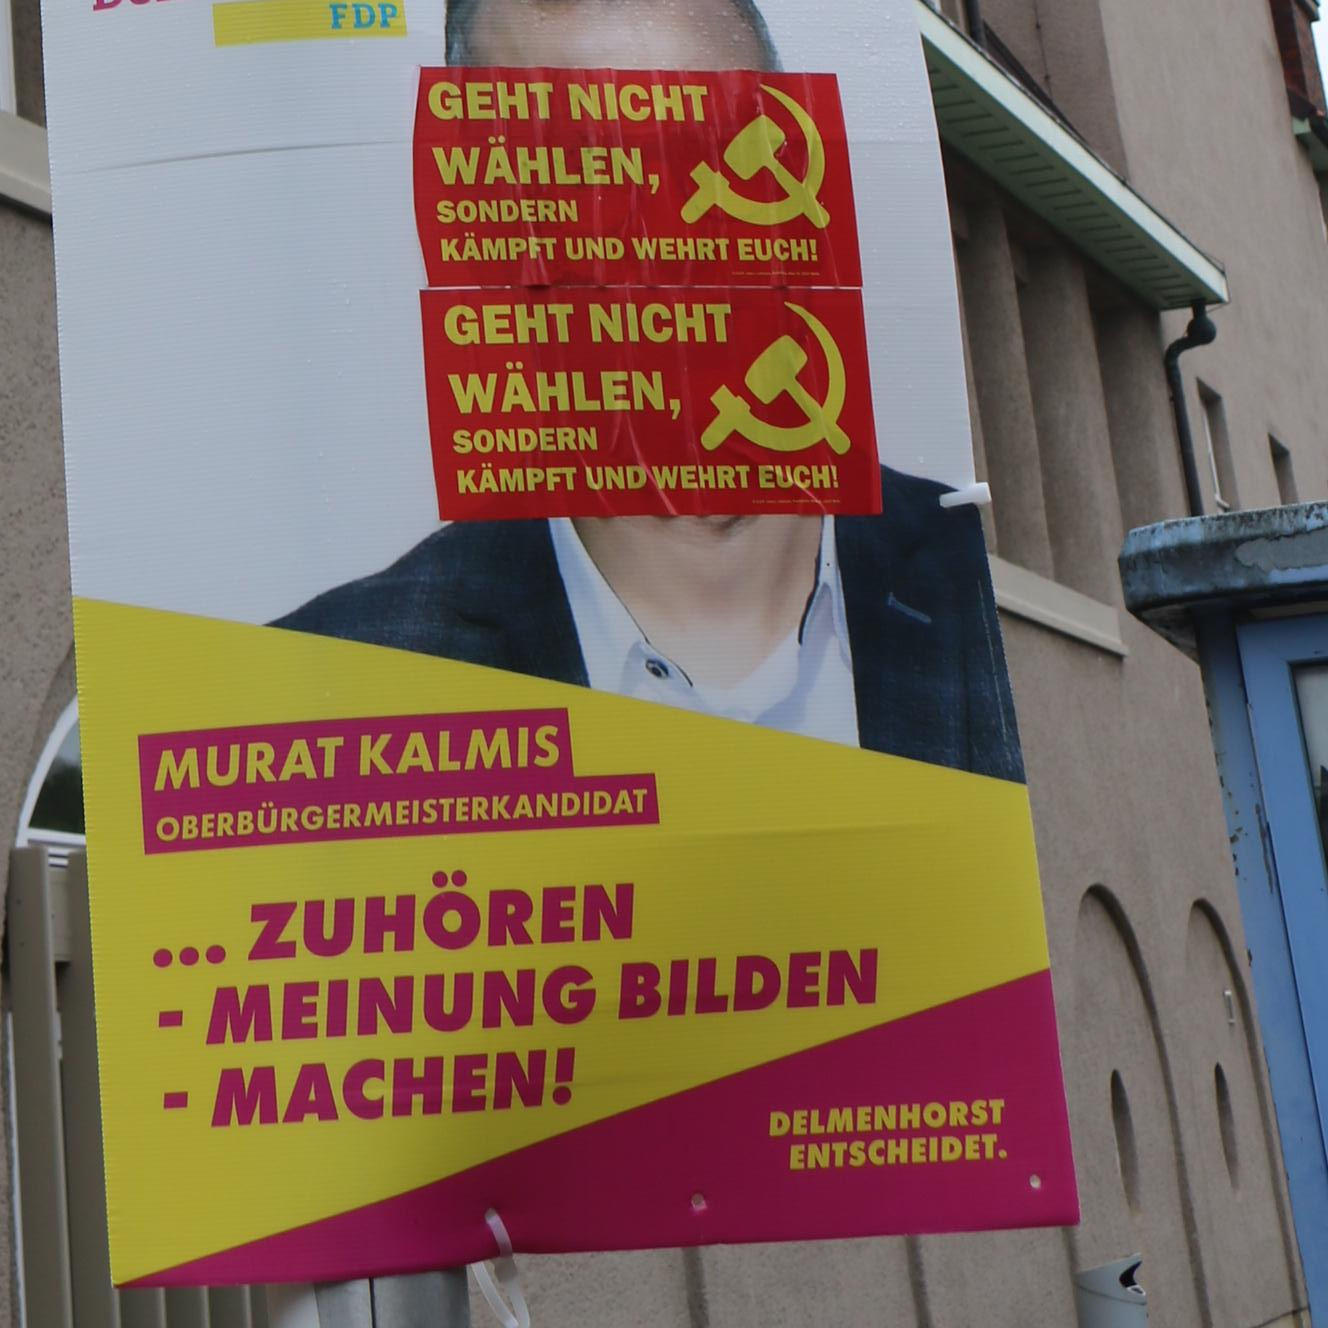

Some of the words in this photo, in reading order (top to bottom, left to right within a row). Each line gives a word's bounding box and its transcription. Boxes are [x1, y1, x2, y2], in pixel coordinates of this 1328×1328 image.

[330, 3, 399, 30] FDP
[428, 81, 553, 121] GEHT
[567, 83, 708, 122] NICHT
[431, 136, 660, 193] WÄHLEN,
[436, 199, 578, 224] SONDERN
[440, 230, 557, 262] KÄMPFT
[564, 238, 625, 261] UND
[631, 238, 729, 261] WEHRT
[737, 238, 818, 262] EUCH!
[443, 304, 574, 346] GEHT
[589, 303, 731, 343] NICHT
[447, 361, 681, 420] WÄHLEN,
[453, 427, 598, 454] SONDERN
[457, 462, 577, 494] KÄMPFT
[585, 466, 647, 491] UND
[652, 465, 750, 489] WEHRT
[758, 465, 838, 490] EUCH!
[154, 736, 344, 791] MURAT
[359, 726, 560, 776] KALMIS
[156, 789, 647, 842] OBERBÜRGERMEISTERKANDIDAT
[247, 871, 635, 962] ZUHÖREN
[206, 967, 597, 1046] MEINUNG
[619, 950, 878, 1021] BILDEN
[211, 1050, 574, 1129] MACHEN!
[769, 1100, 1004, 1137] DELMENHORST
[790, 1134, 1008, 1170] ENTSCHEIDET.
